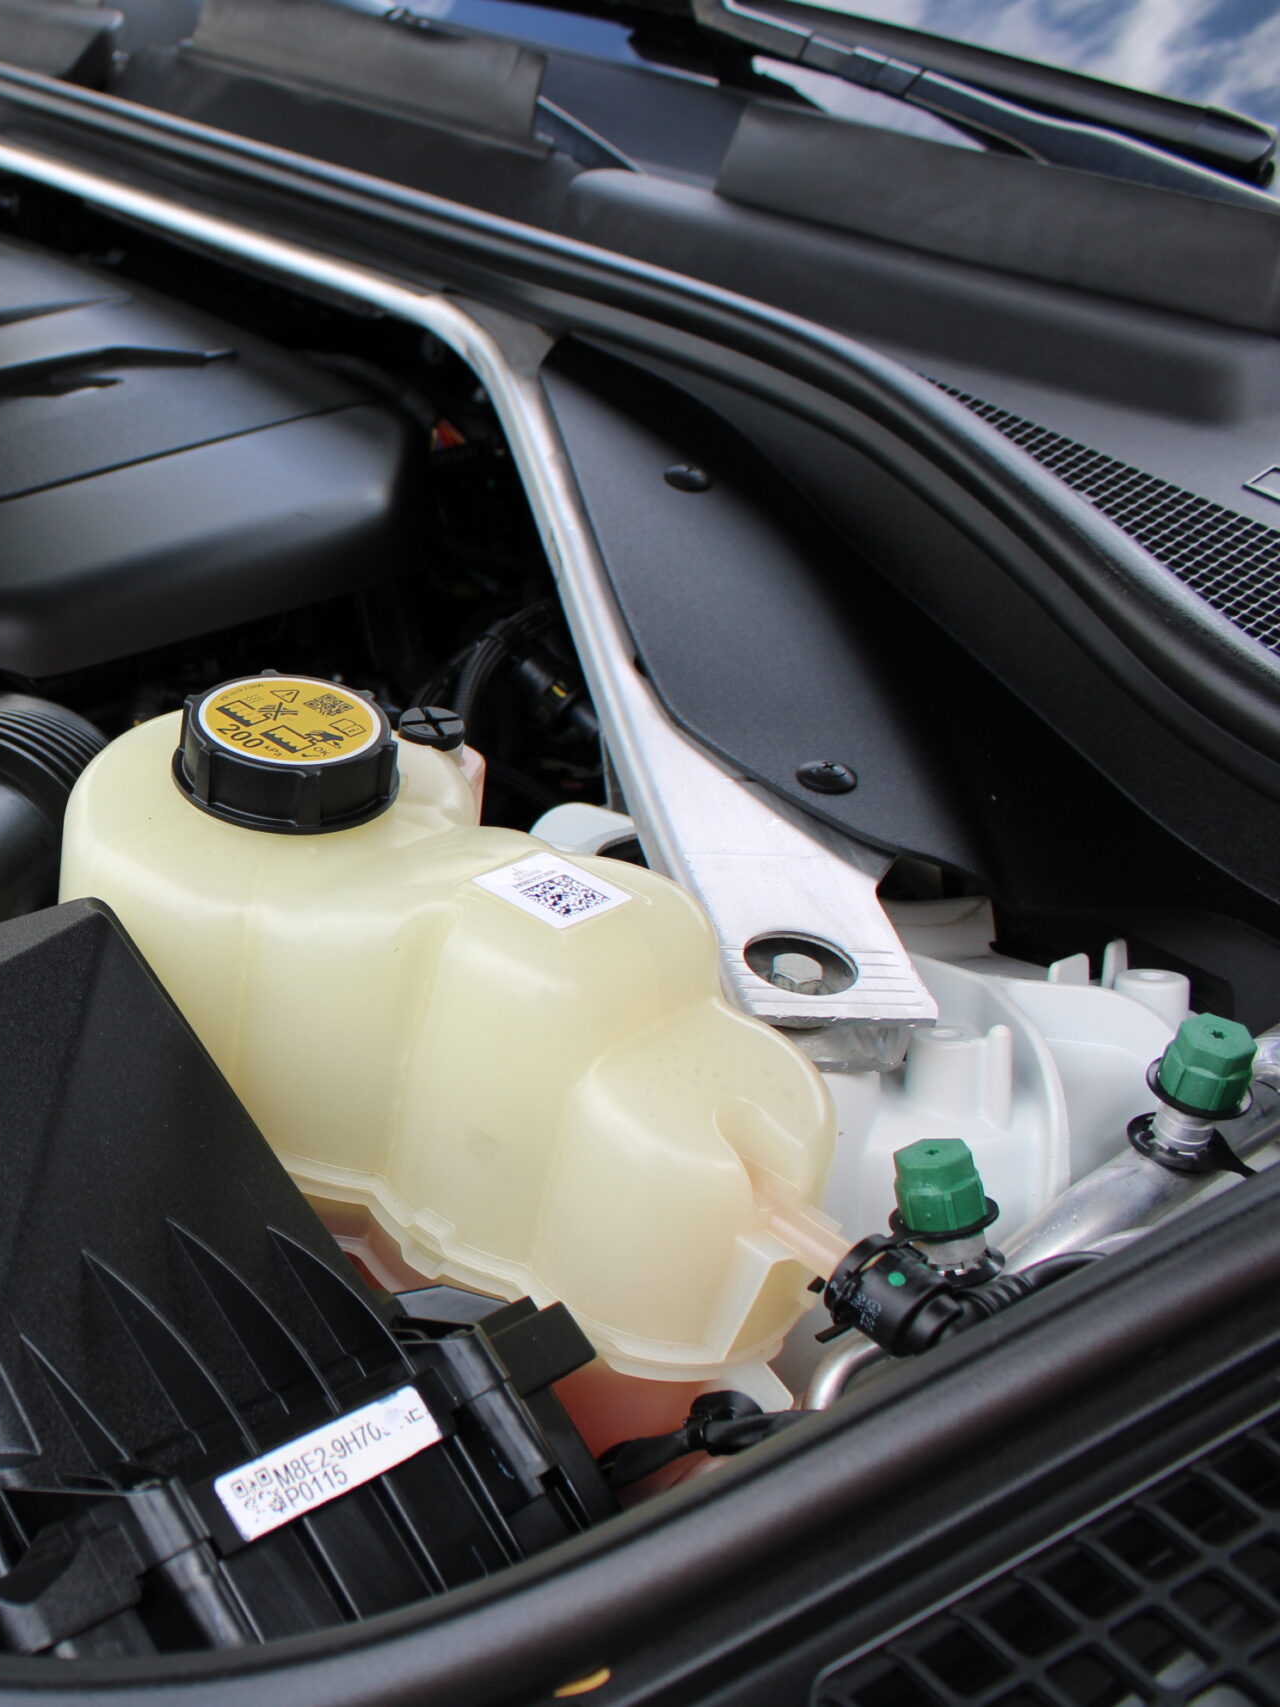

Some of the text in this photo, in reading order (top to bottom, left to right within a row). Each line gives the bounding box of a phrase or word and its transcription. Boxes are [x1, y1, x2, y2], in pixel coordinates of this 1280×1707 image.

[216, 723, 283, 757] 200 kPa
[313, 746, 331, 757] OK
[284, 1463, 349, 1509] P0115
